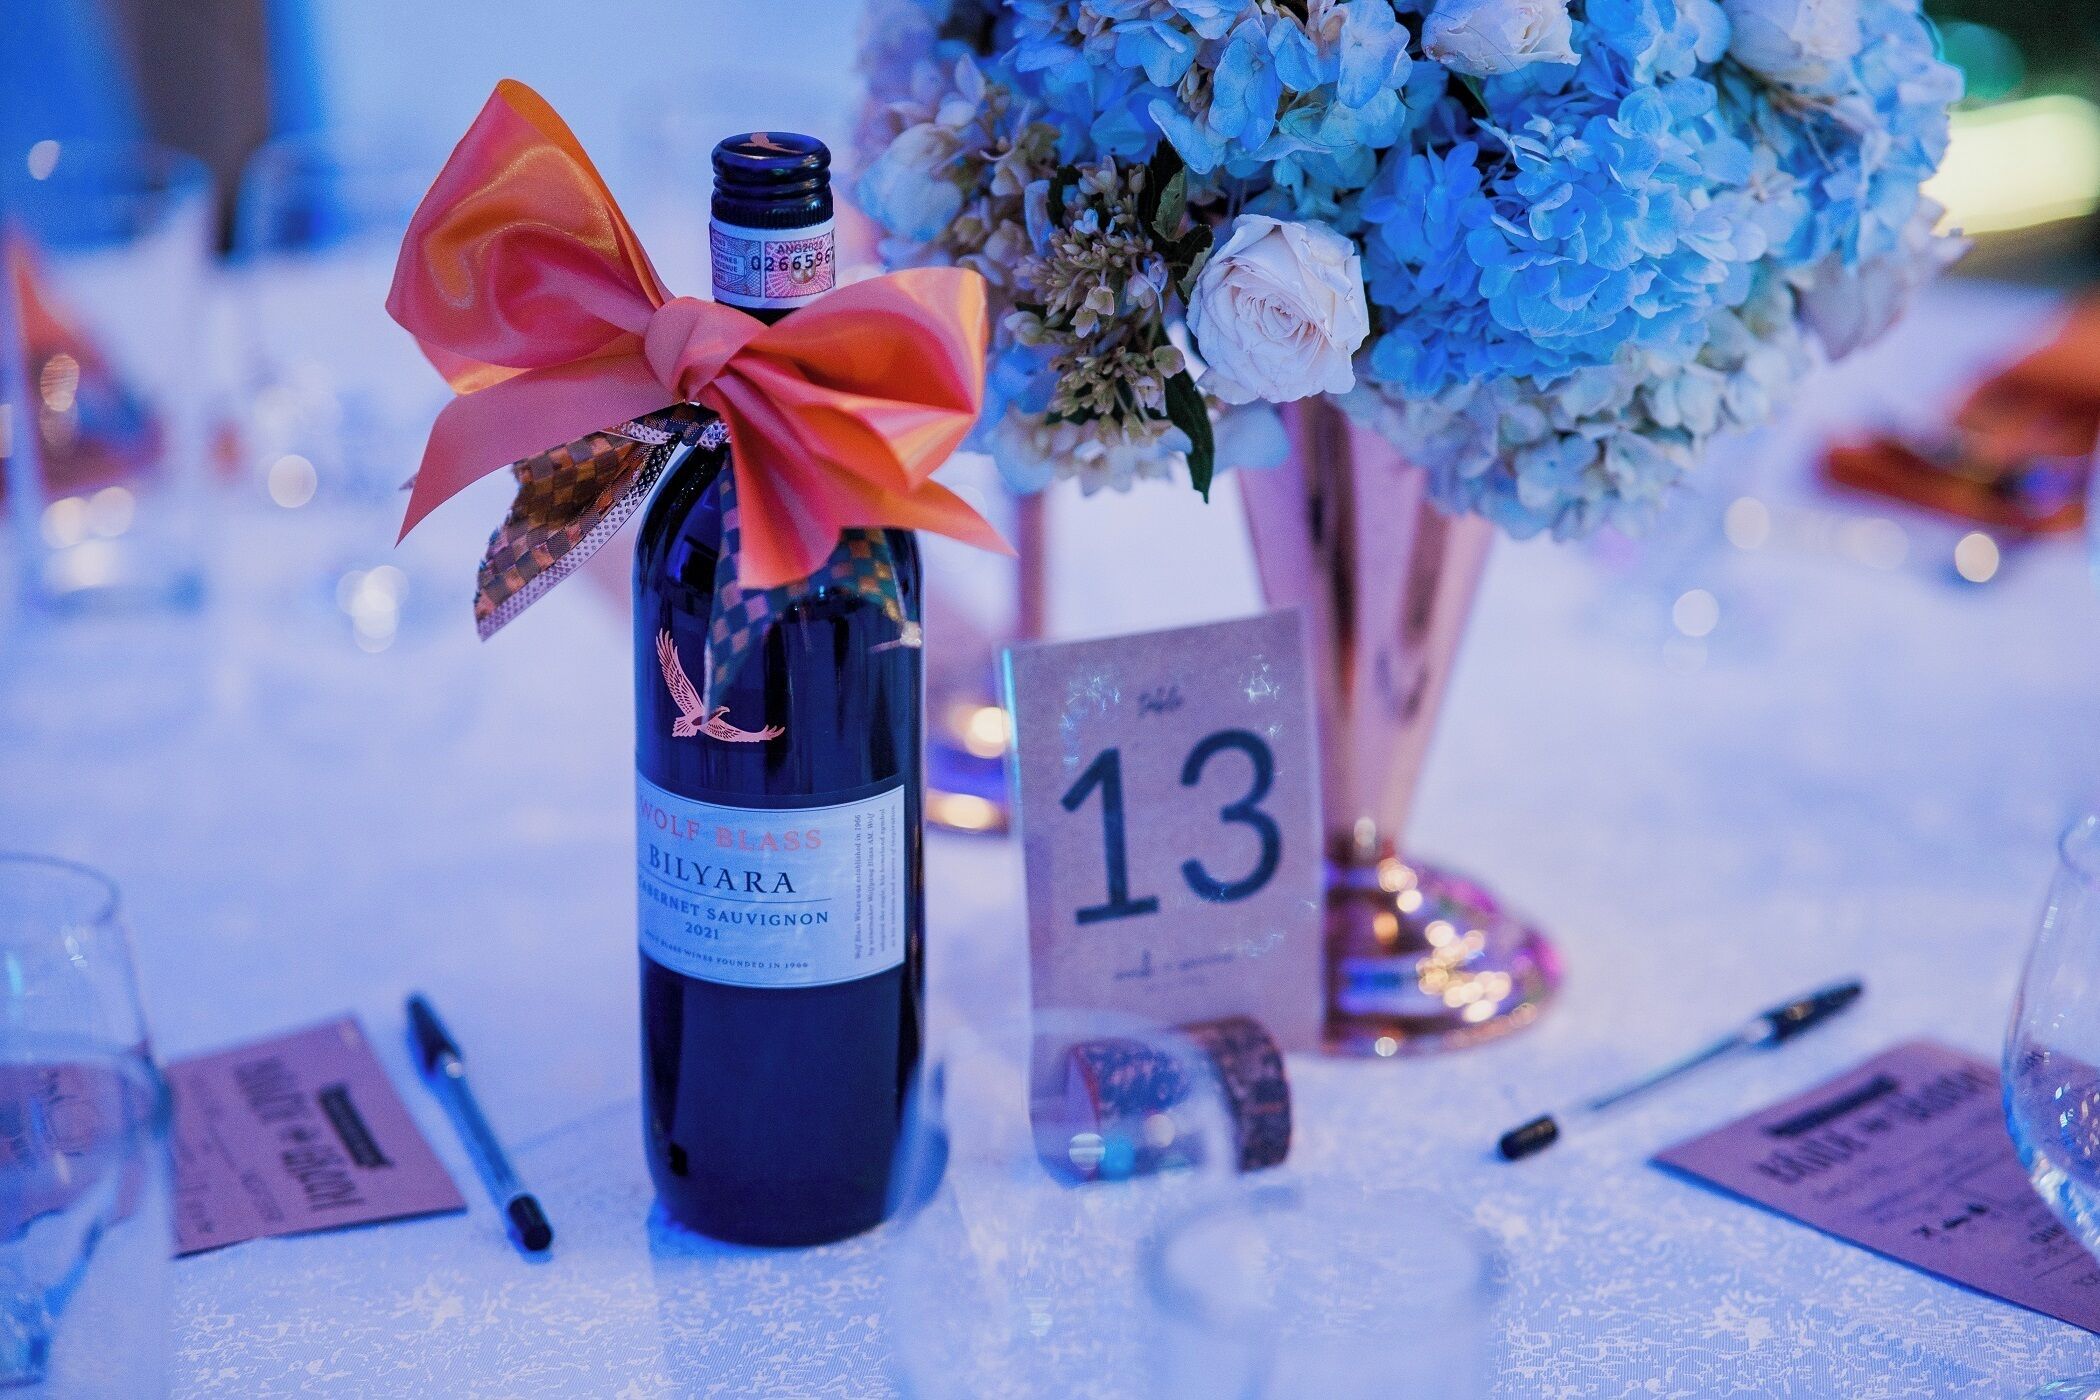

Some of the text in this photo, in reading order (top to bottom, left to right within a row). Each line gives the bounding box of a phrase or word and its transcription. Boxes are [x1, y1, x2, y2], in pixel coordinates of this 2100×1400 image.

[716, 825, 821, 851] BLASS
[1060, 729, 1282, 926] 13
[648, 844, 796, 893] BILYARA
[706, 907, 828, 926] SAUVIGNON
[685, 922, 719, 939] 2021
[716, 957, 764, 969] FOUNDED
